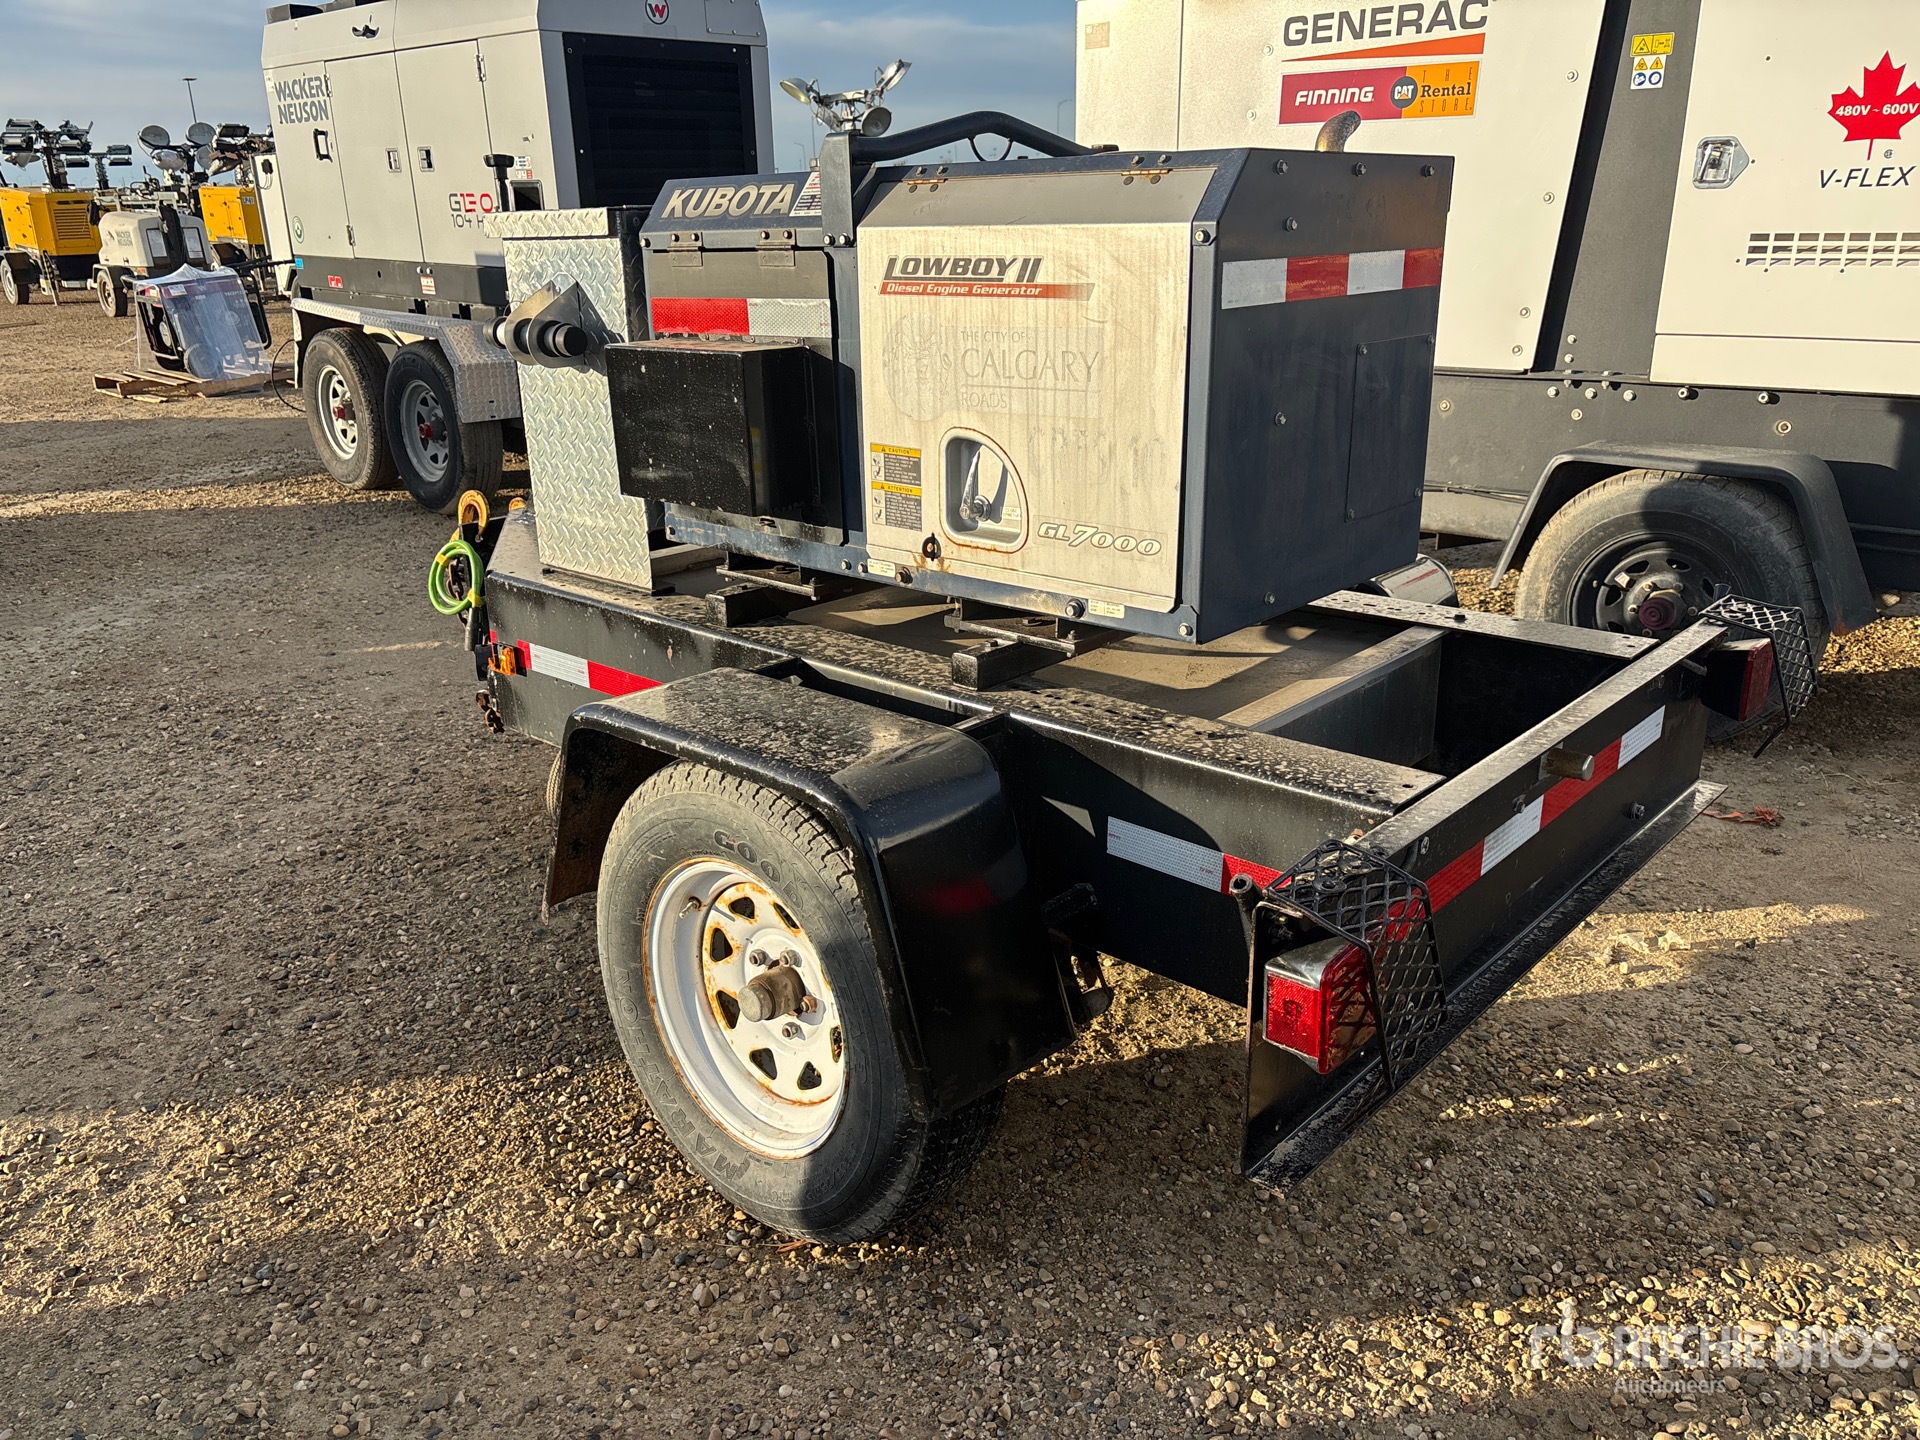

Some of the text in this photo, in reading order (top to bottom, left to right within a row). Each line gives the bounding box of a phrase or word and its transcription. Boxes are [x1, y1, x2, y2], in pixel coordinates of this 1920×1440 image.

[1283, 0, 1489, 47] GENERAC
[274, 76, 326, 102] WACKER
[1295, 86, 1374, 106] FINNING
[1394, 84, 1415, 100] CAT
[1420, 82, 1472, 98] Rental
[277, 99, 330, 124] NEUSON
[1835, 105, 1871, 116] 480V
[1882, 103, 1919, 115] 600V
[1820, 165, 1917, 188] V-FLEX
[661, 183, 795, 219] KUBOTA
[451, 214, 472, 228] 104
[884, 257, 1043, 284] LOWBOY II
[886, 283, 1042, 296] Diesel Engine Generator
[961, 331, 1026, 343] THE CITY OF
[961, 348, 1099, 383] CALGARY
[961, 392, 1008, 409] ROADS
[888, 447, 910, 455] CAUTION
[888, 485, 913, 493] ATTENTION
[1038, 521, 1162, 556] GL7000
